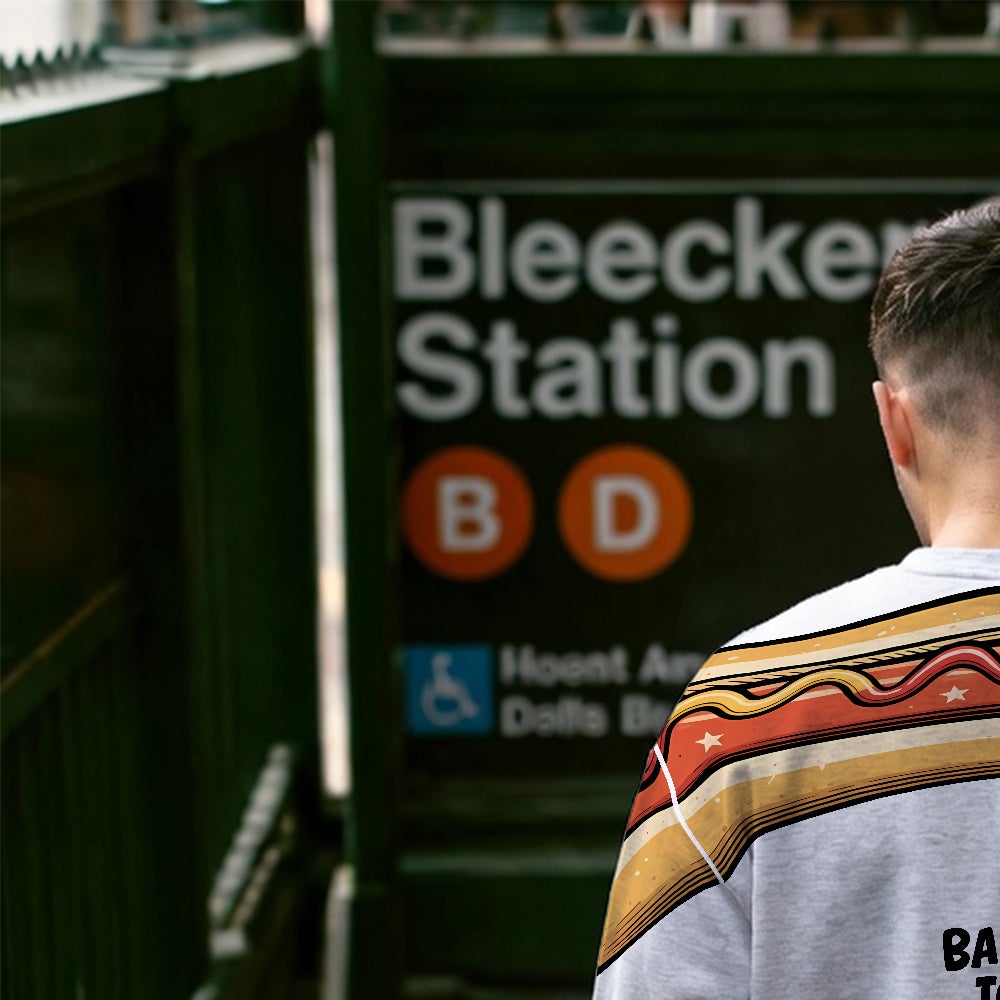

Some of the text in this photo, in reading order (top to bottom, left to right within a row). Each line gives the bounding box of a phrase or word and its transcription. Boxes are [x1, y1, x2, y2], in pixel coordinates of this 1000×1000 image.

[399, 314, 836, 419] Station
[438, 475, 660, 552] B D
